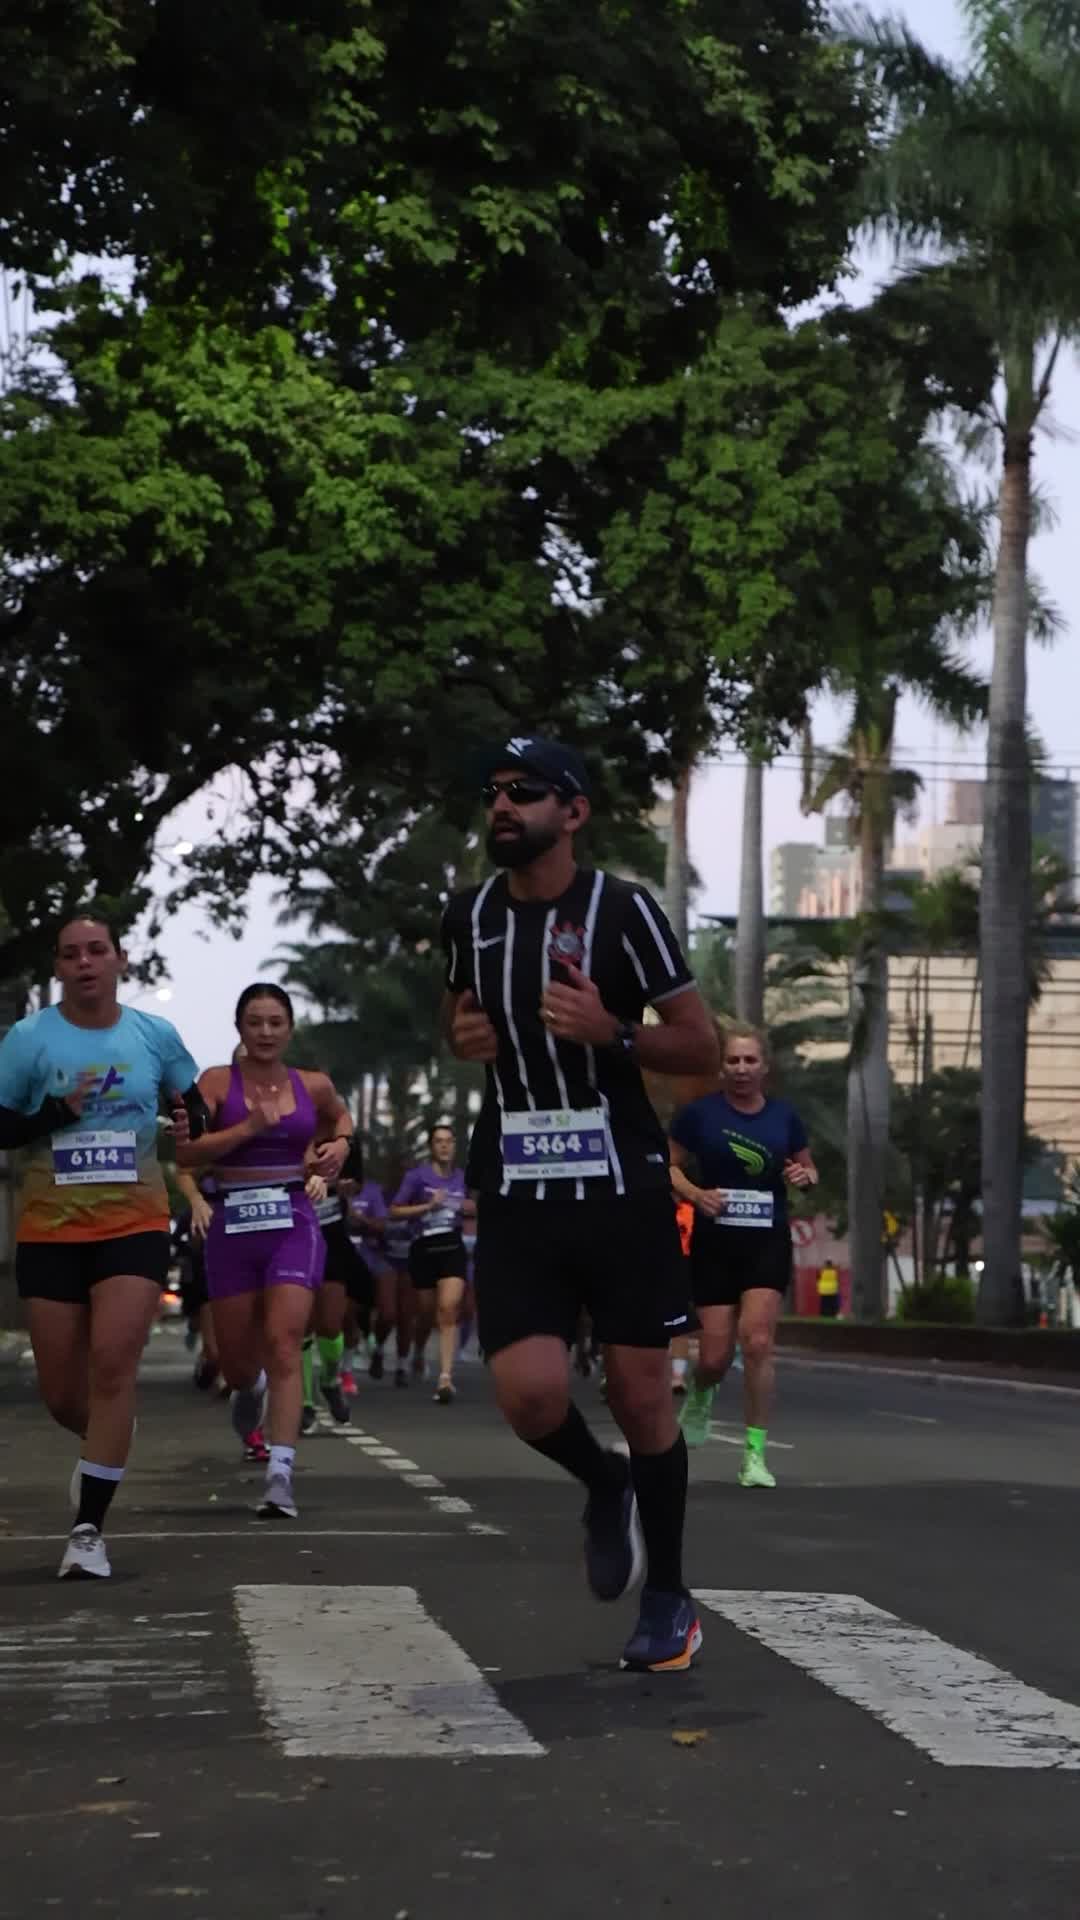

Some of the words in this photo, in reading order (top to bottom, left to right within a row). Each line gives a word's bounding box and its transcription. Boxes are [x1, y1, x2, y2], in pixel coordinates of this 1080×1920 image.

[522, 1134, 582, 1156] 5464
[70, 1149, 119, 1166] 6144
[239, 1203, 278, 1218] 5013
[727, 1203, 761, 1215] 6036
